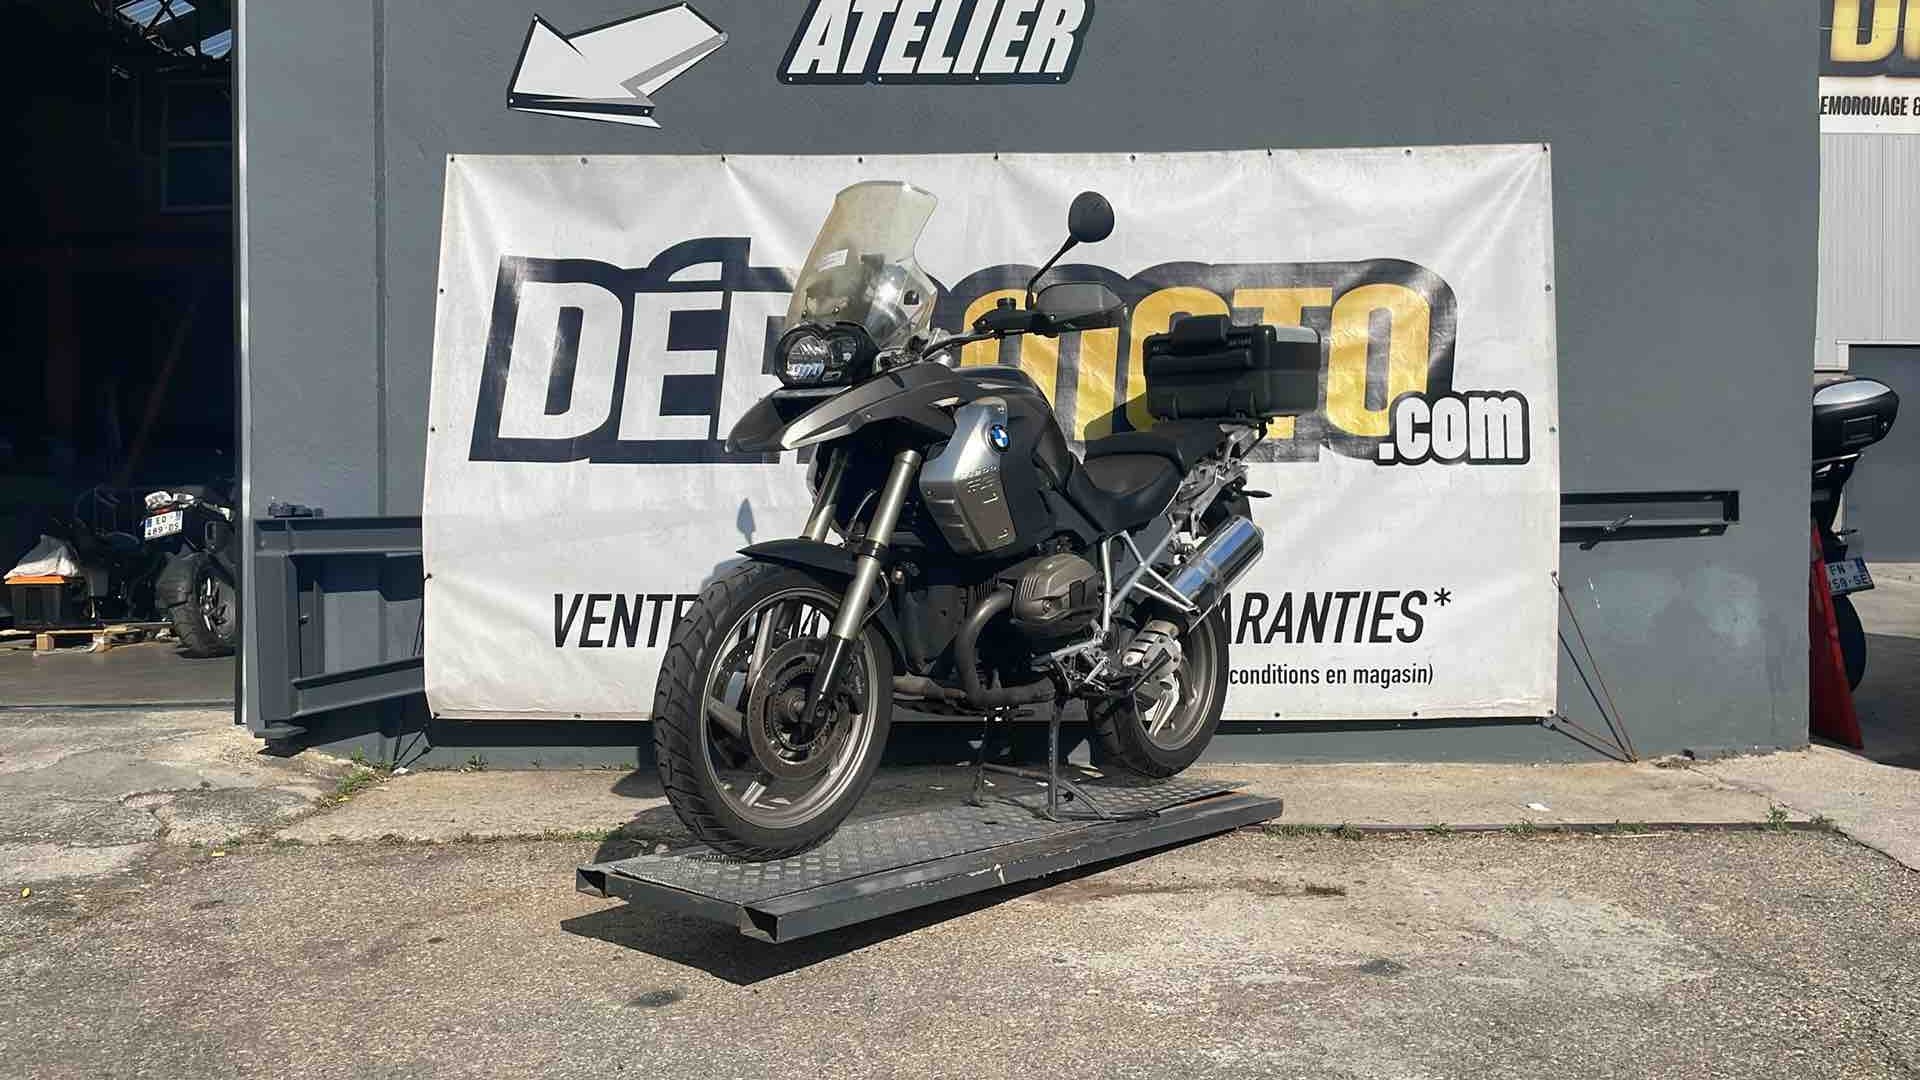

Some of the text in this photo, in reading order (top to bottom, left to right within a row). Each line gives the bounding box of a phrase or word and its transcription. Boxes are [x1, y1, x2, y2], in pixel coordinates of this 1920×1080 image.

[786, 0, 1086, 74] ATELIER
[1377, 395, 1525, 462] .com
[1229, 663, 1434, 688] conditions en magasin)
